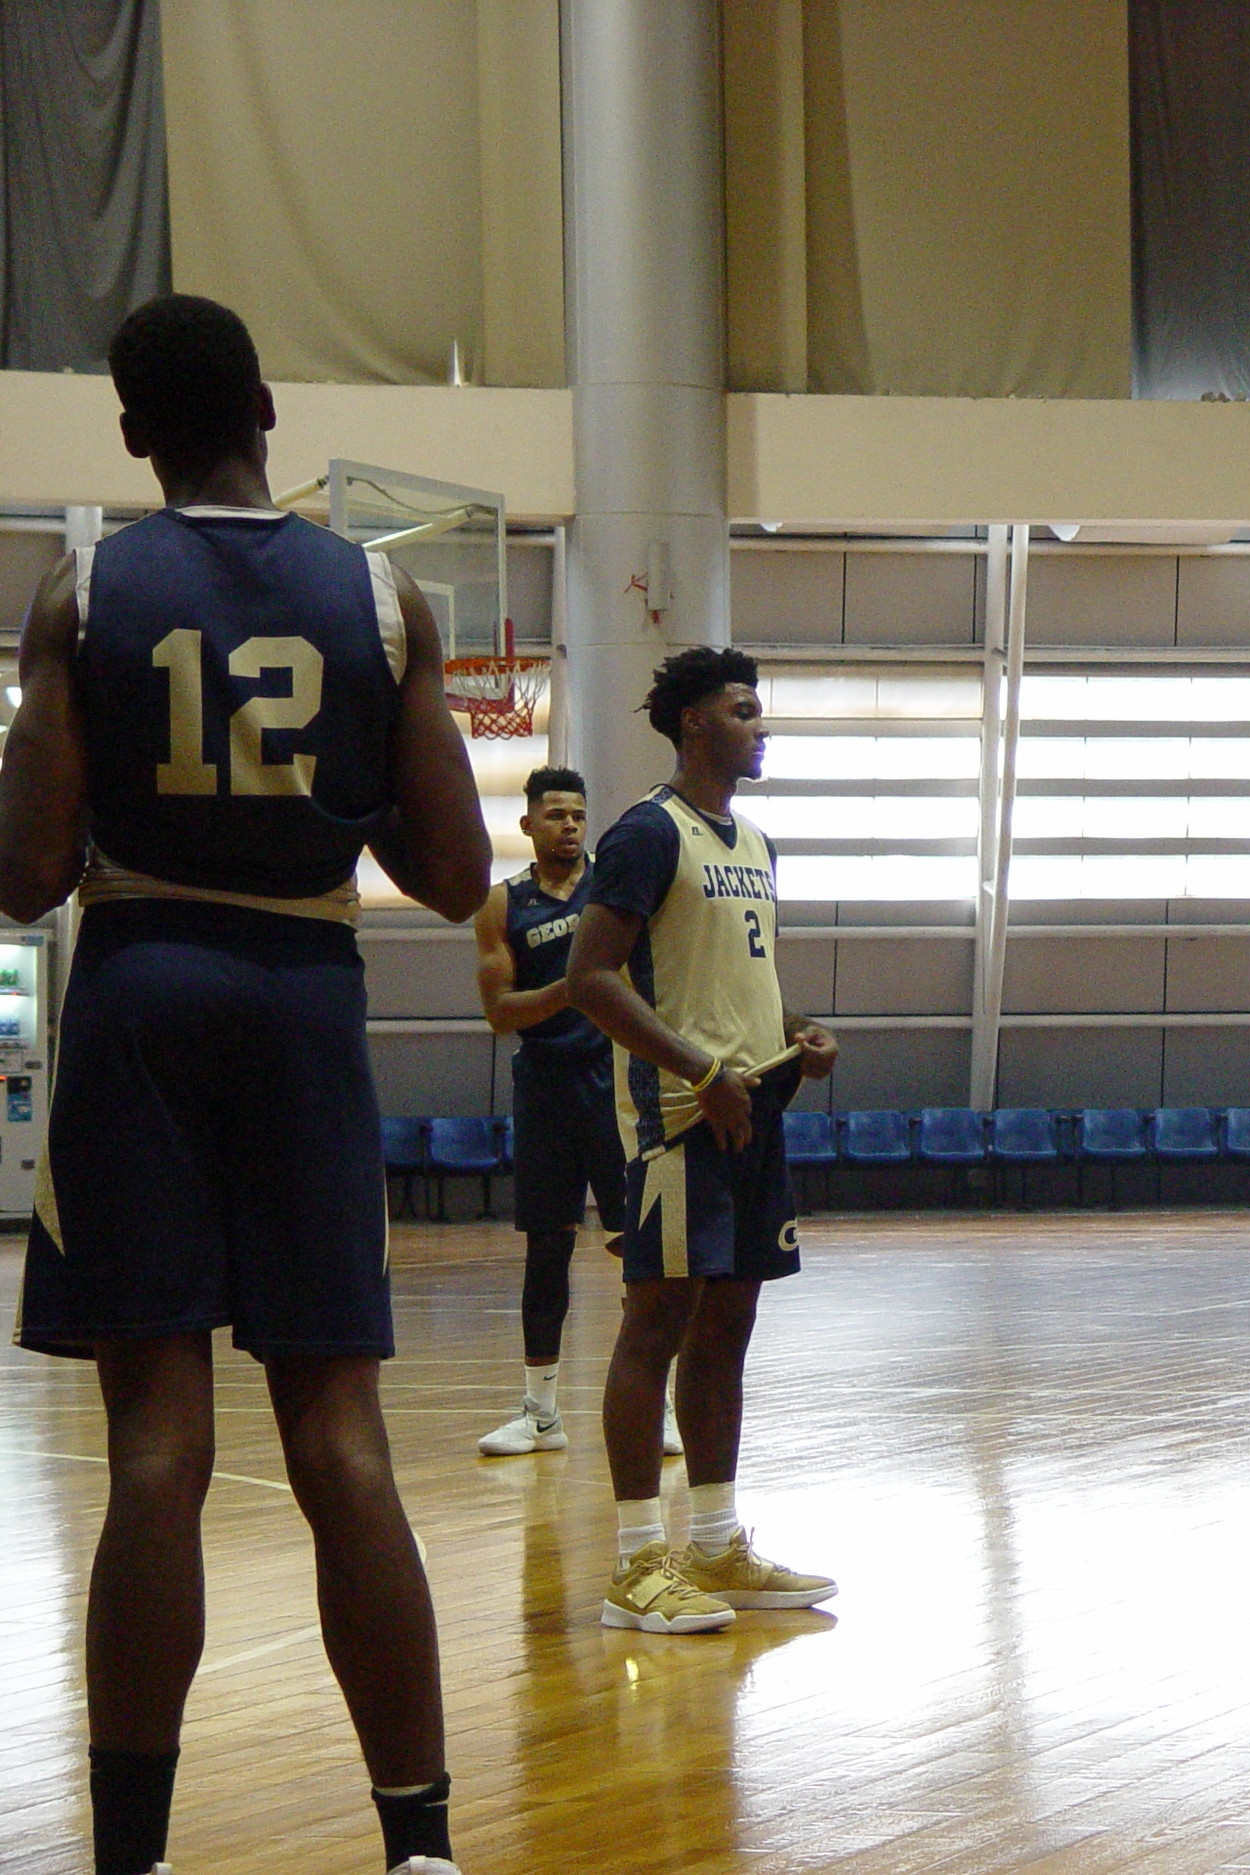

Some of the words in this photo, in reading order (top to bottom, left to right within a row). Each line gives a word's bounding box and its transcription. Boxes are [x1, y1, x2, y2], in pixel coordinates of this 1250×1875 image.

[151, 628, 325, 796] 12
[702, 864, 776, 903] JACKETS
[526, 913, 580, 949] GEOR
[744, 909, 767, 958] 2
